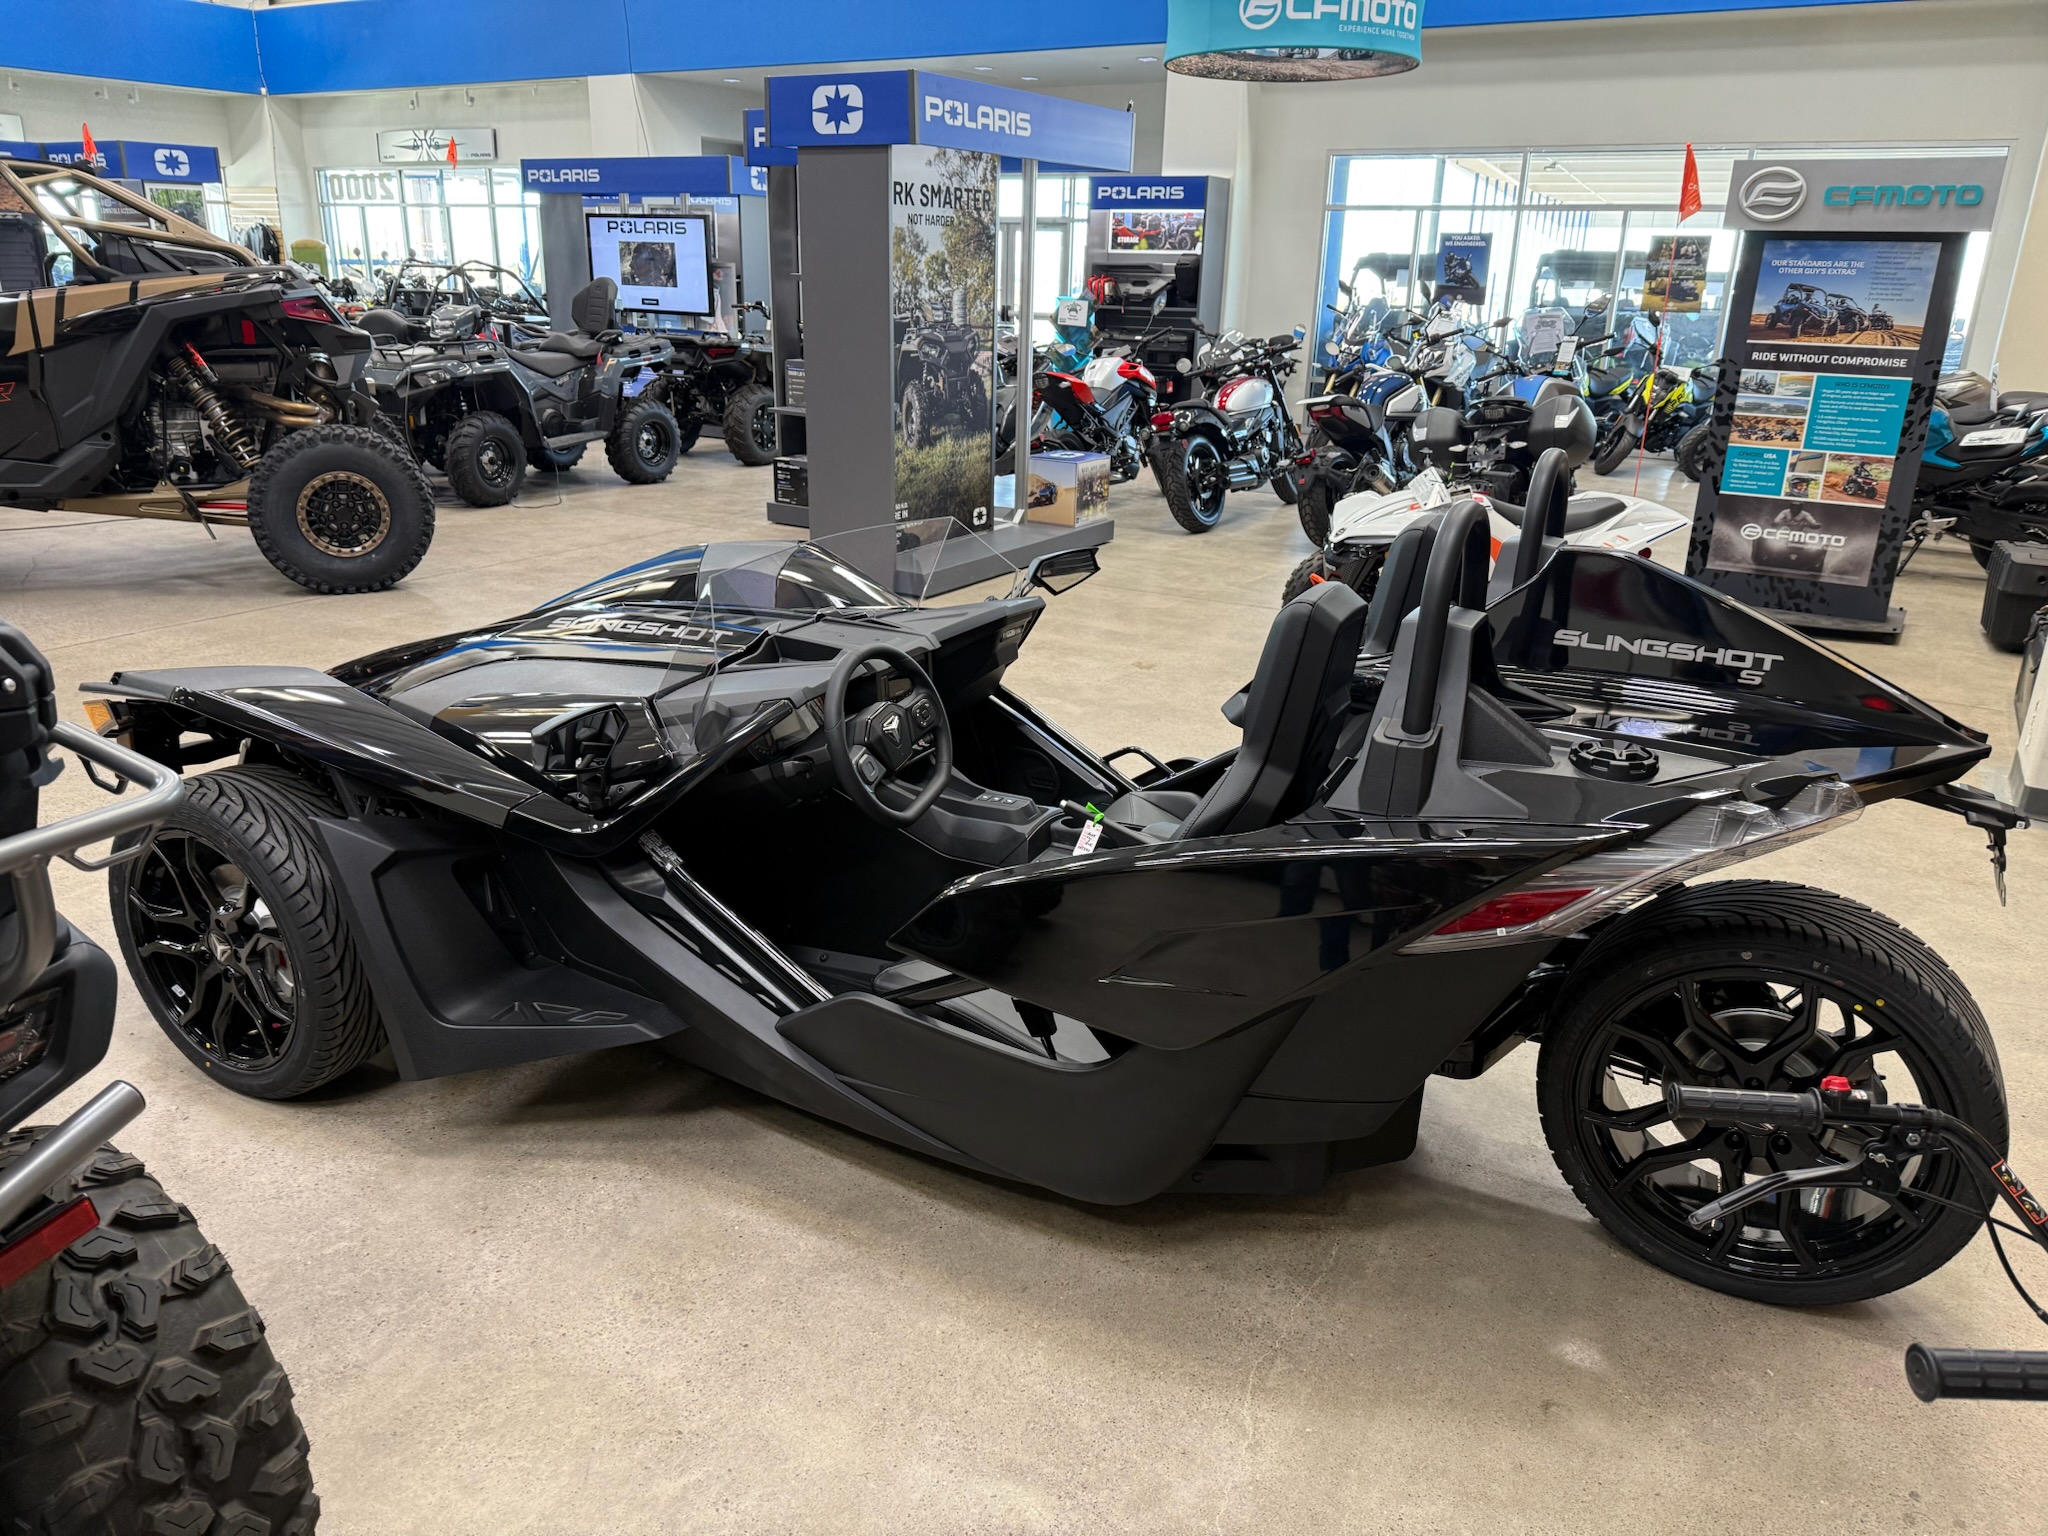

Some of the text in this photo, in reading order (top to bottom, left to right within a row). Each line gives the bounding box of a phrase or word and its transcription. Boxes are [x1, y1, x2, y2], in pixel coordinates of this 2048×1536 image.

[1339, 24, 1379, 35] EXPERIENCE
[1381, 28, 1396, 37] MORE
[925, 95, 1031, 137] POLARIS
[49, 152, 107, 168] POLAIS
[527, 168, 600, 183] POLARIS
[919, 183, 991, 212] SMARTER
[1097, 186, 1185, 200] POLARIS
[1823, 184, 1984, 207] CFMOTO
[607, 221, 687, 235] POLARIS
[907, 213, 955, 227] NOT HARDER
[1117, 236, 1140, 244] STORAGE
[1751, 351, 1908, 368] RIDE WITHOUT COMPROMISE
[1762, 528, 1846, 547] CFMOTO
[547, 616, 734, 643] SLINGSHOT
[1553, 628, 1785, 671] SLINGSHOT
[1737, 669, 1766, 686] S
